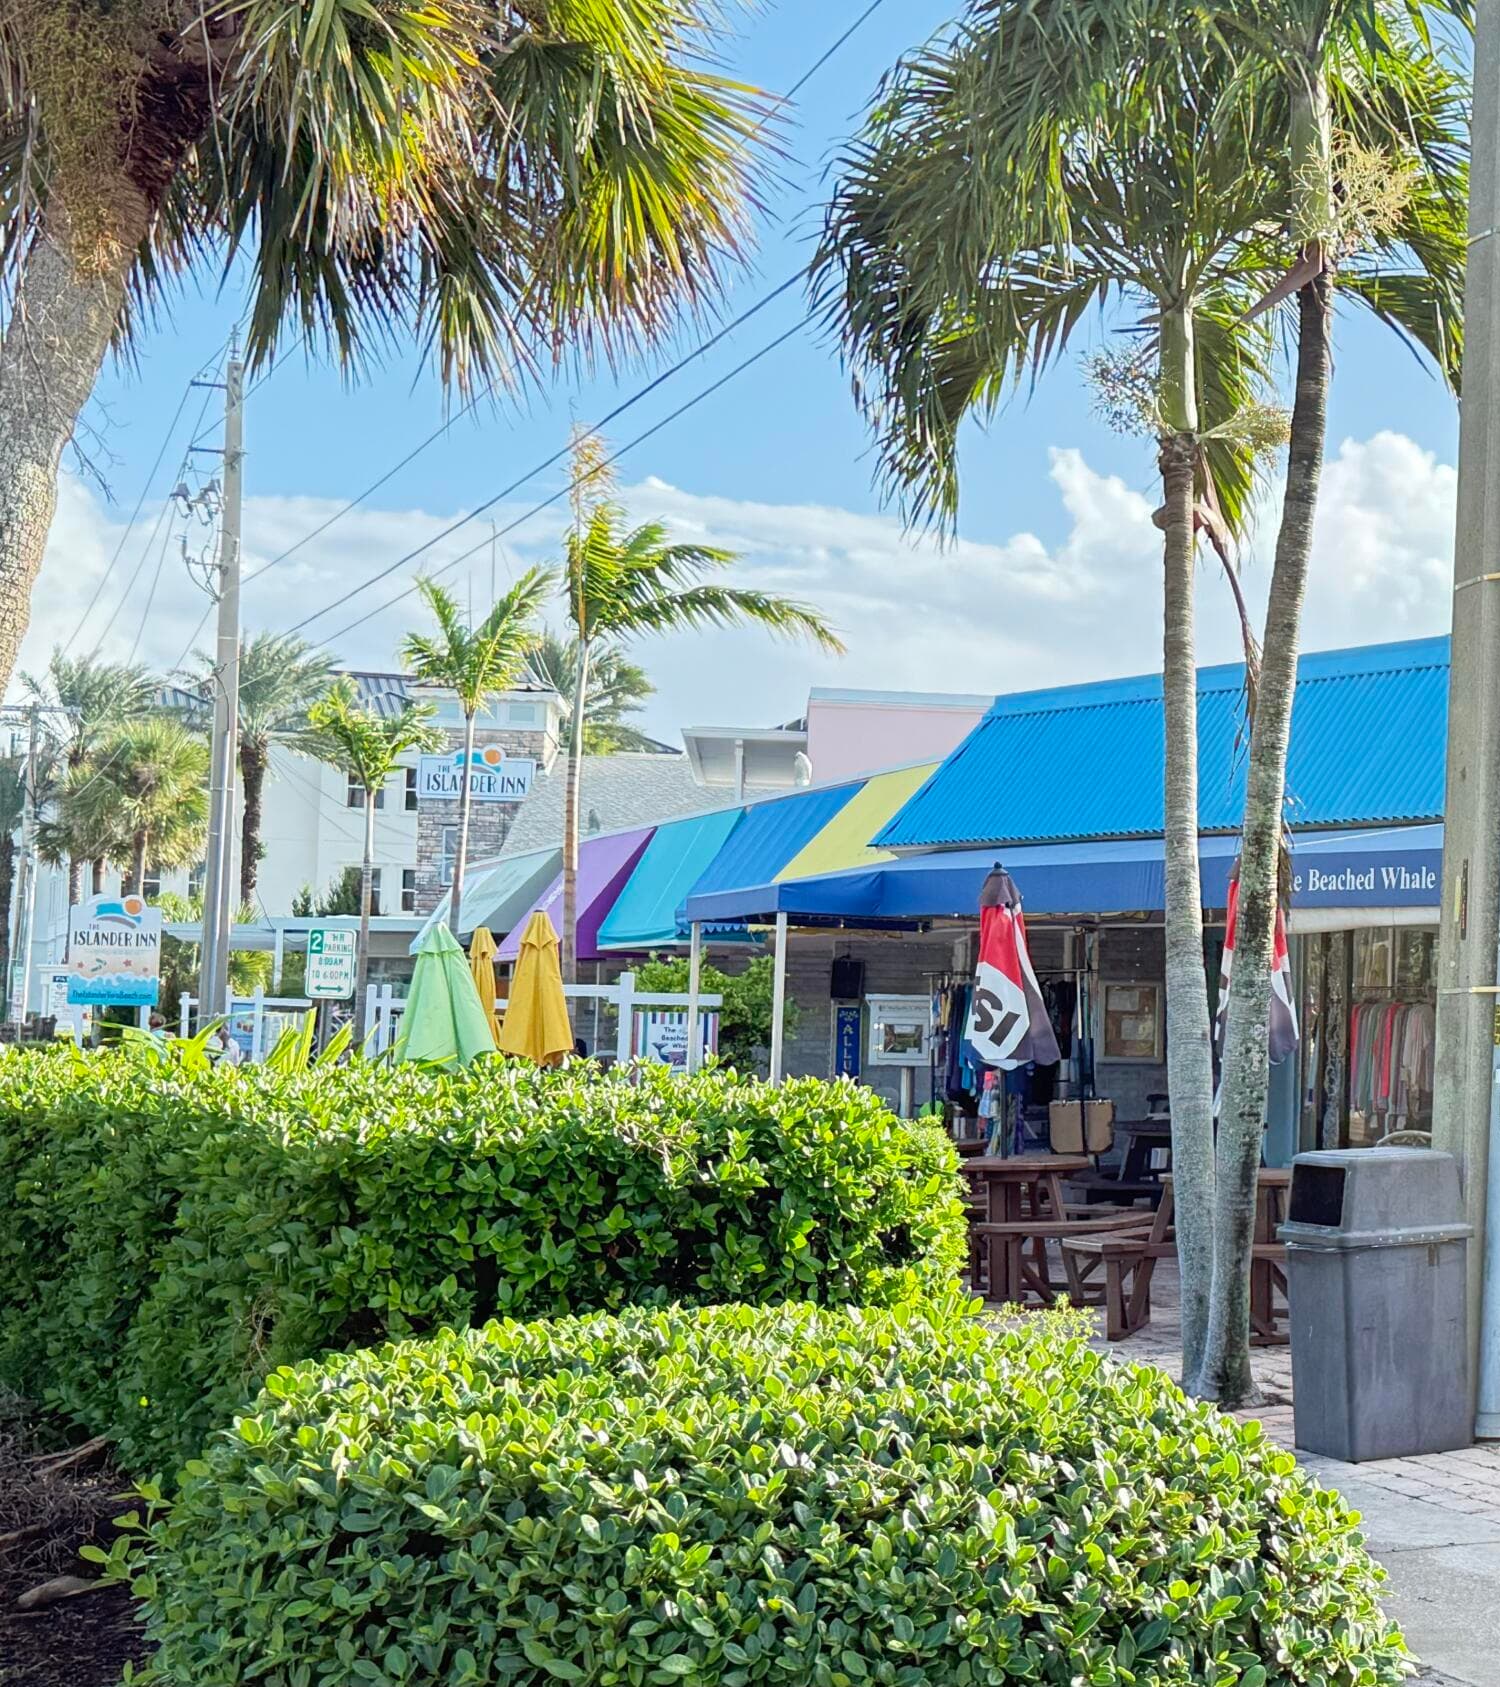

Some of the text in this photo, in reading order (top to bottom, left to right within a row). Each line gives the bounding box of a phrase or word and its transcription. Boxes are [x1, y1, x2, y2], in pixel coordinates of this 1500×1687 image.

[501, 776, 526, 793] INN
[1308, 867, 1375, 892] Beached
[1381, 866, 1436, 890] Whale
[73, 930, 157, 947] ISLANDER INN
[311, 932, 322, 951] 2
[324, 943, 352, 952] PARKING
